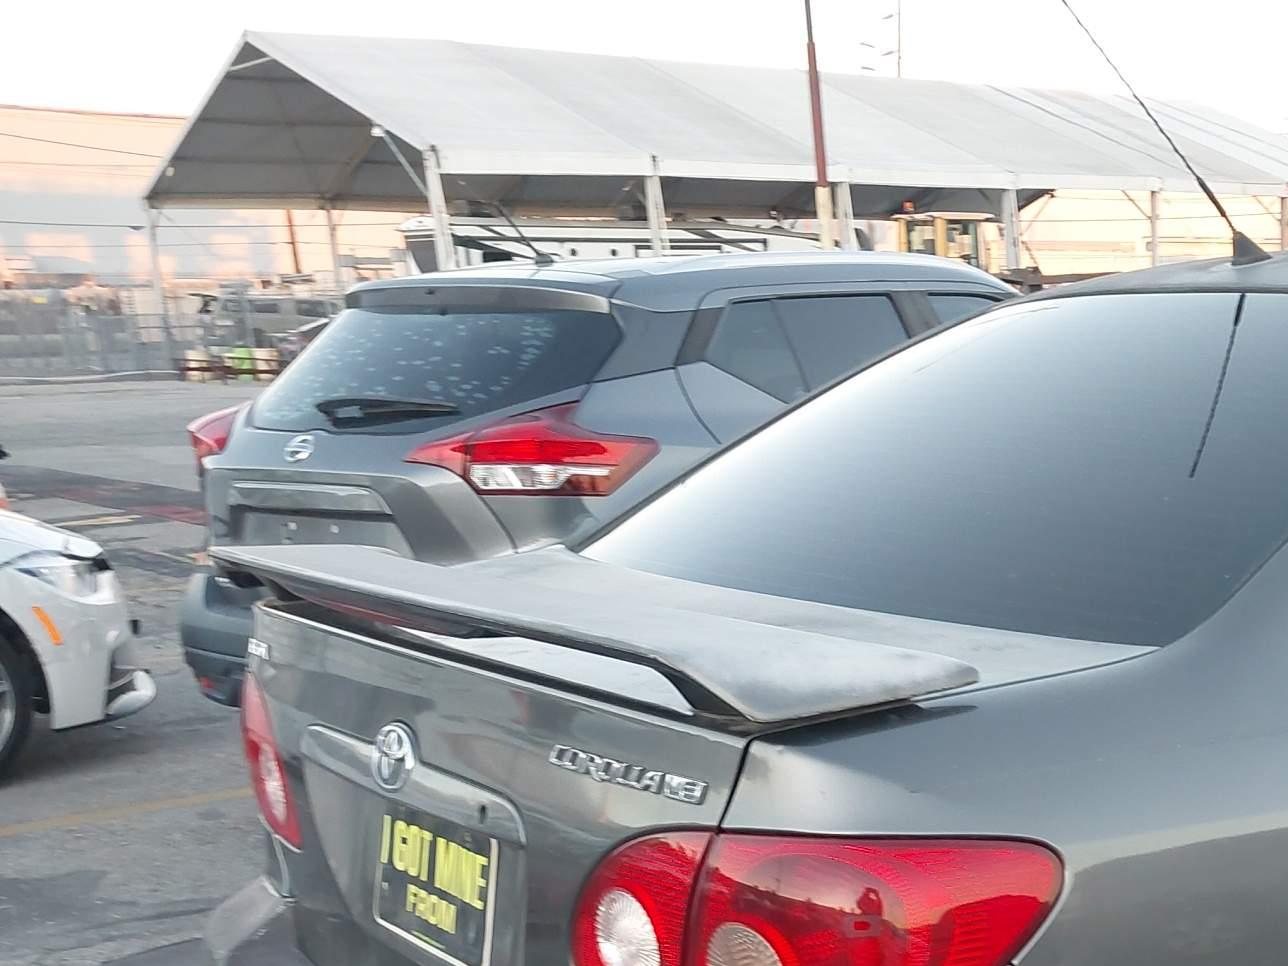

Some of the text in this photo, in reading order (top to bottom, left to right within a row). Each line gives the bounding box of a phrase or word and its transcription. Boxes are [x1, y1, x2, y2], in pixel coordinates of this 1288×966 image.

[549, 744, 665, 795] COROLLA
[380, 814, 489, 910] I GOT MINE
[405, 883, 456, 934] FROM
